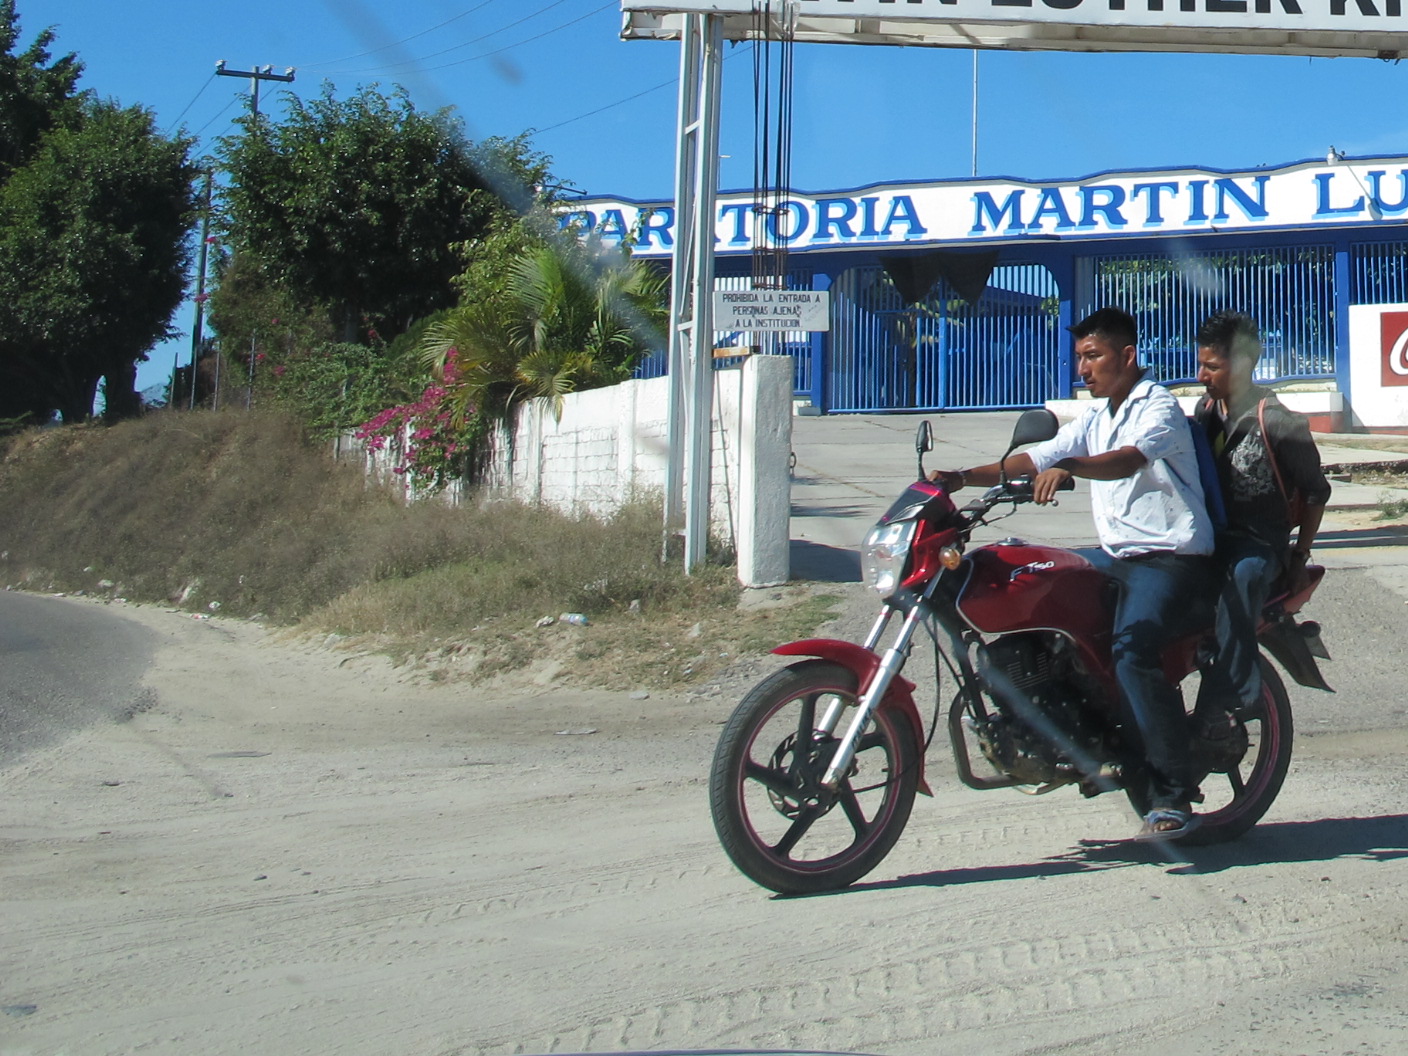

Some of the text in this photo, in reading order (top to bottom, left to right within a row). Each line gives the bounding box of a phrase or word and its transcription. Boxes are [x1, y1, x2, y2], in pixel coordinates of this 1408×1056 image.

[559, 194, 927, 250] PARTORIA
[968, 175, 1270, 237] MARTIN
[723, 293, 821, 303] PROHIBIDA LA ENTRADA A
[733, 305, 802, 316] PERSONAS AJENAS
[735, 318, 741, 328] A
[743, 318, 752, 328] LA
